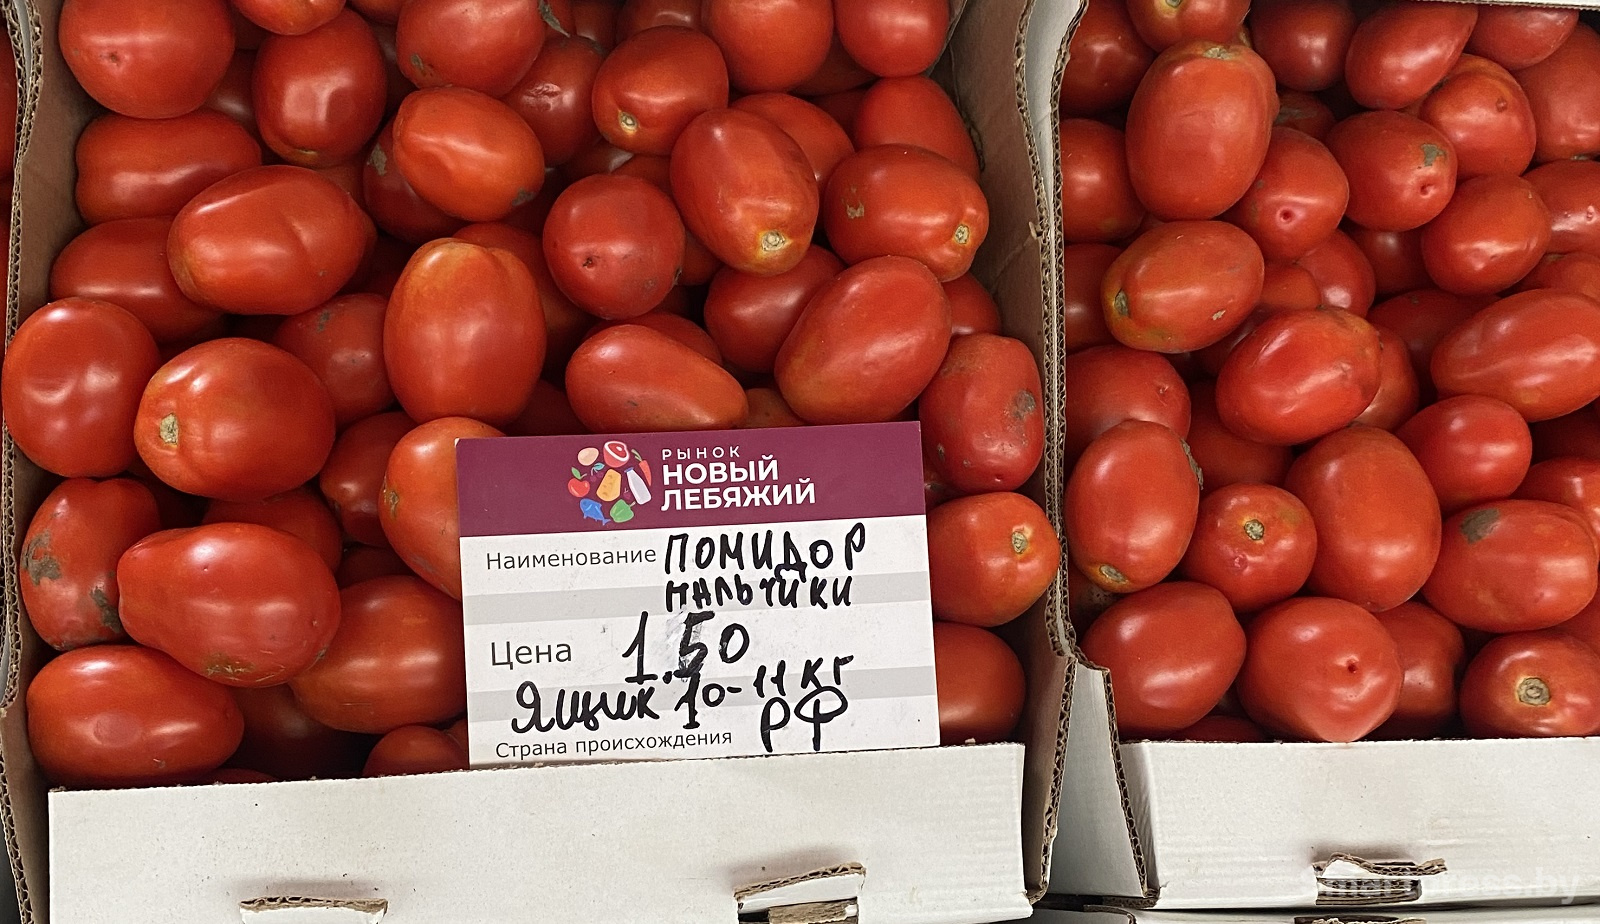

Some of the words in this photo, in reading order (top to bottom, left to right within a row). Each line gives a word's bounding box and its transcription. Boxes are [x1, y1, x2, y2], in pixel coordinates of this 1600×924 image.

[661, 446, 740, 460] РЫНОК
[662, 454, 779, 485] НОВЫЙ
[660, 477, 816, 511] ЛЕБЯЖИЙ
[486, 546, 657, 570] Наименование
[664, 522, 866, 582] ПОМИДОР
[491, 641, 573, 670] Цена
[622, 610, 750, 685] 1.50
[511, 680, 660, 733] Ящик
[760, 685, 849, 752] РФ
[495, 742, 568, 761] Страна
[575, 732, 733, 755] происхождения
